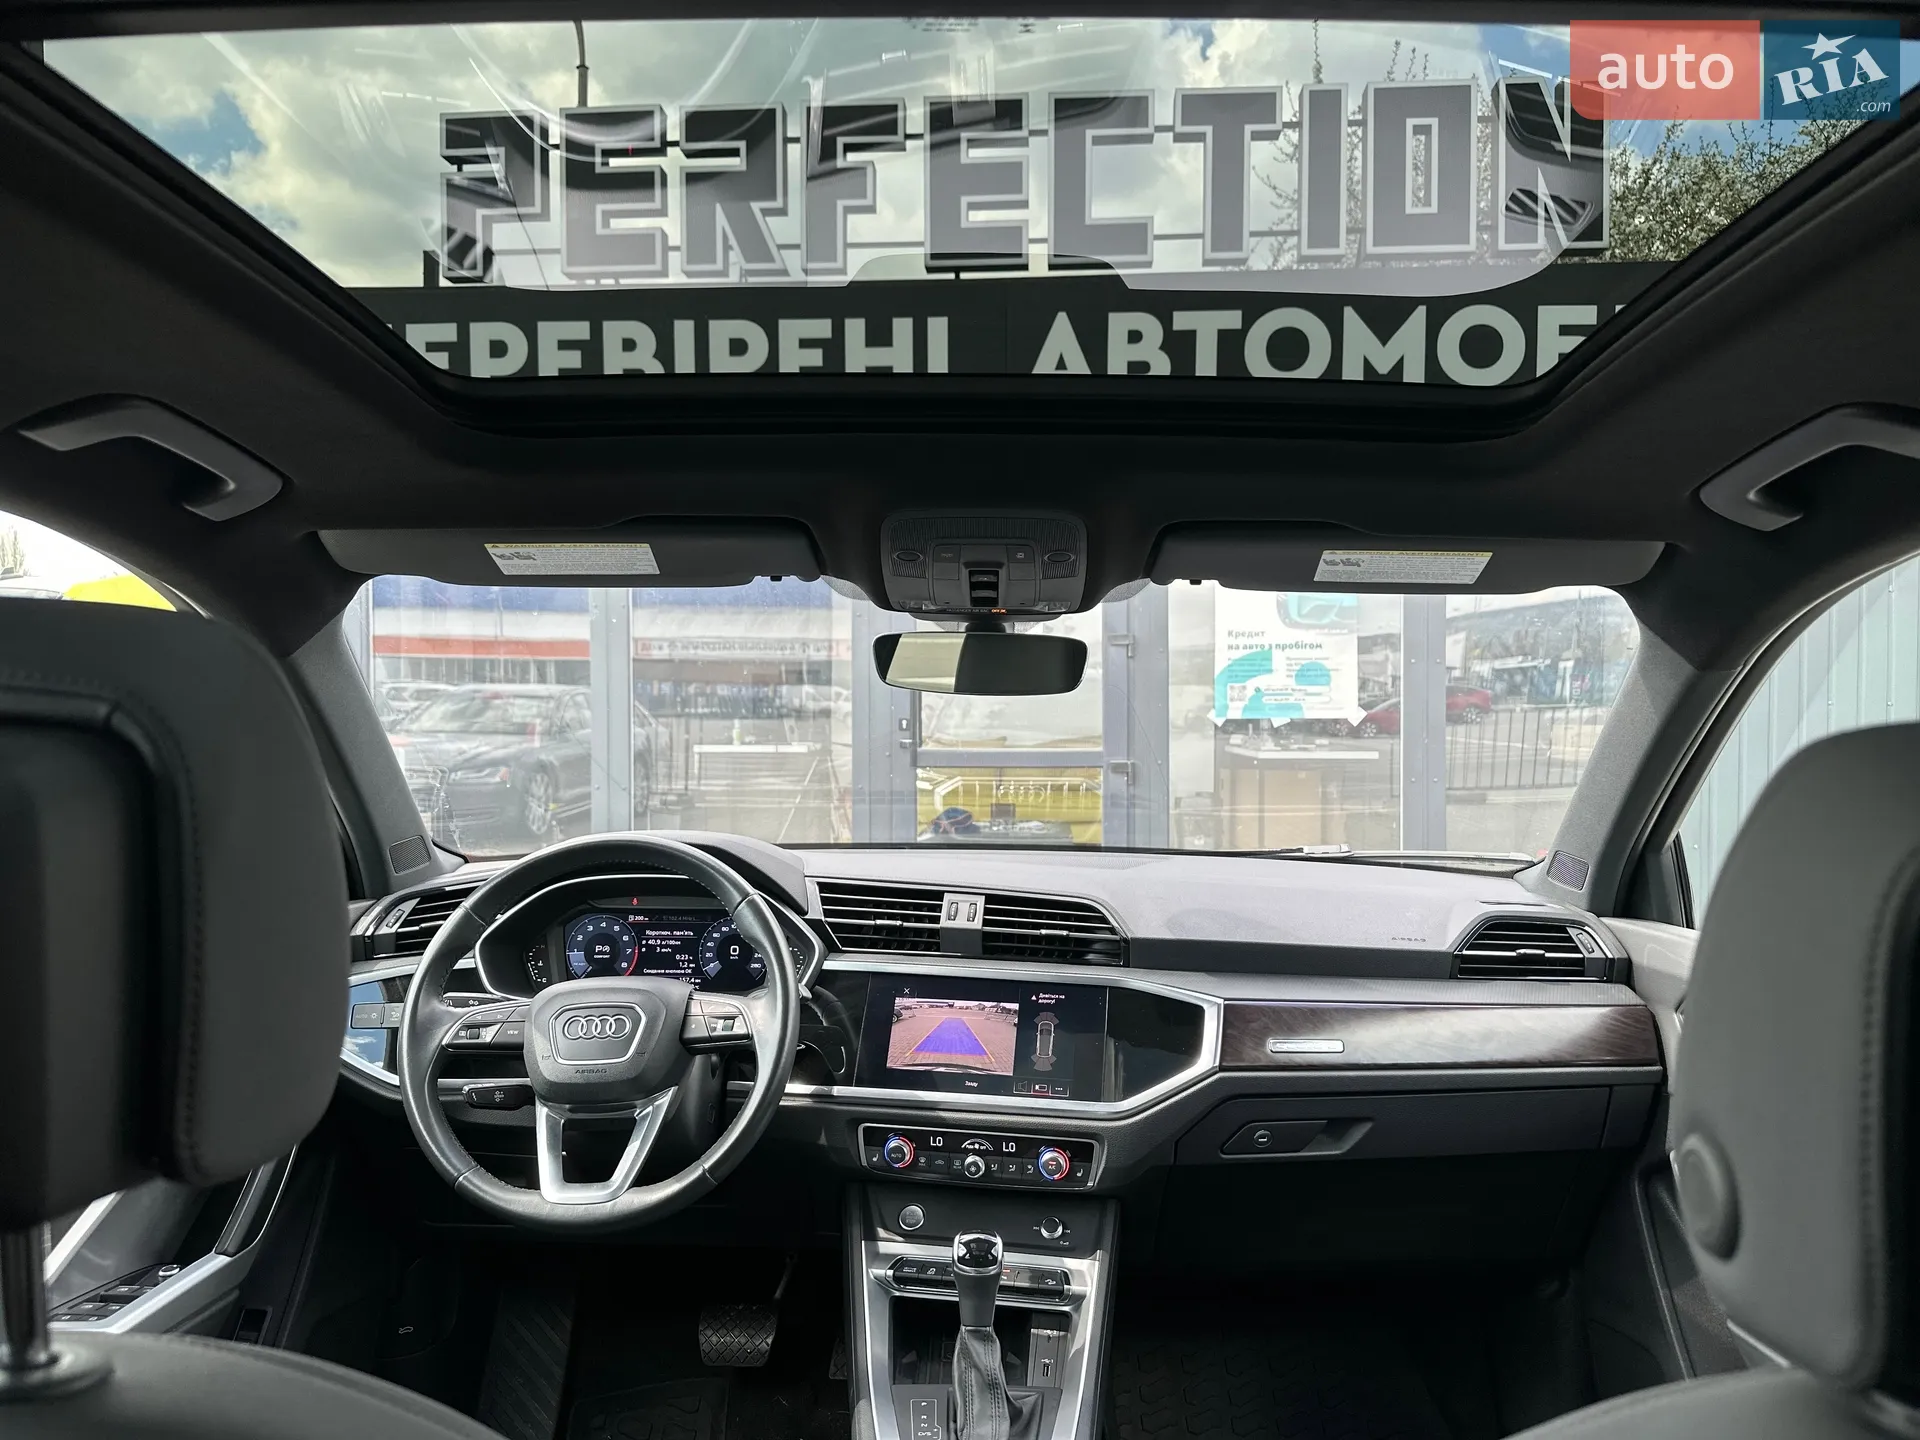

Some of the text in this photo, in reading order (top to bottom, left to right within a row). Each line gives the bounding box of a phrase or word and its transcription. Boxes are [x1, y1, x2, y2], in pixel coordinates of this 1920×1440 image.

[440, 78, 1610, 284] PERFECTION
[386, 304, 1627, 387] ЕРЕВІРЕНІ АВТОМОБ
[1227, 630, 1266, 639] Кредит
[1227, 643, 1241, 651] на
[1275, 640, 1323, 652] пробігом
[595, 945, 602, 953] P
[730, 945, 739, 955] 0
[930, 1135, 943, 1147] LO
[1002, 1141, 1016, 1153] LO
